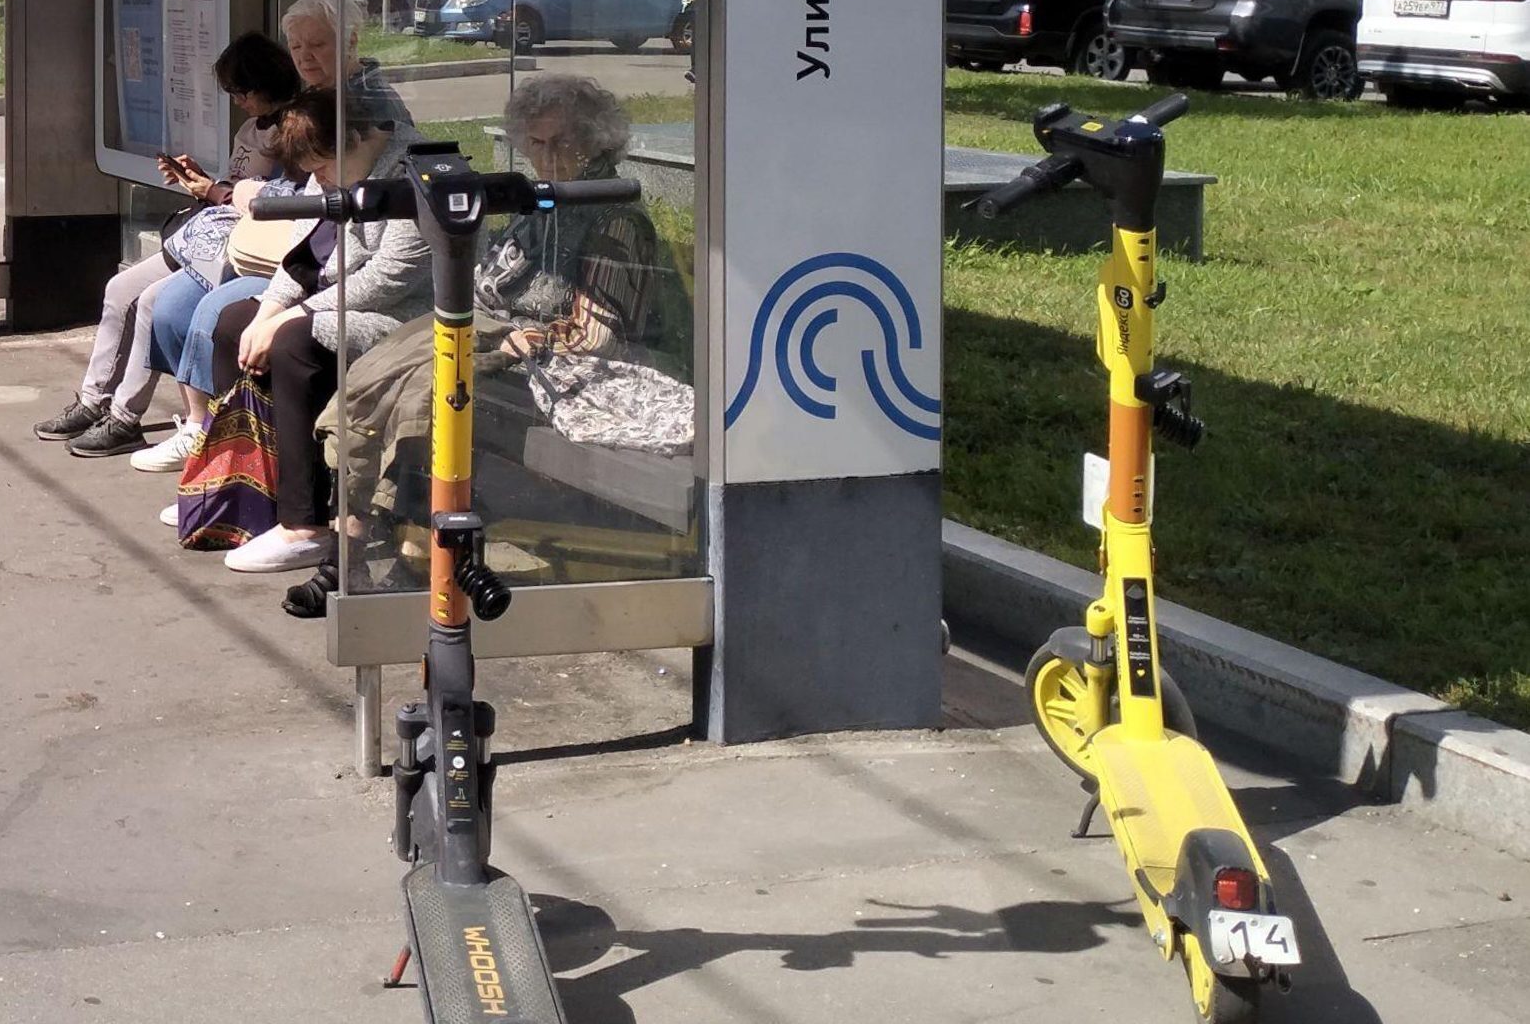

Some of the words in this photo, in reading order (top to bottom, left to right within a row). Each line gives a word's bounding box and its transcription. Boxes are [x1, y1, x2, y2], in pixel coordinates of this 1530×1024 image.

[1117, 289, 1130, 307] Go
[1116, 310, 1130, 355] Яндекс
[1231, 921, 1288, 954] 14
[463, 926, 507, 1015] WHOOSH
